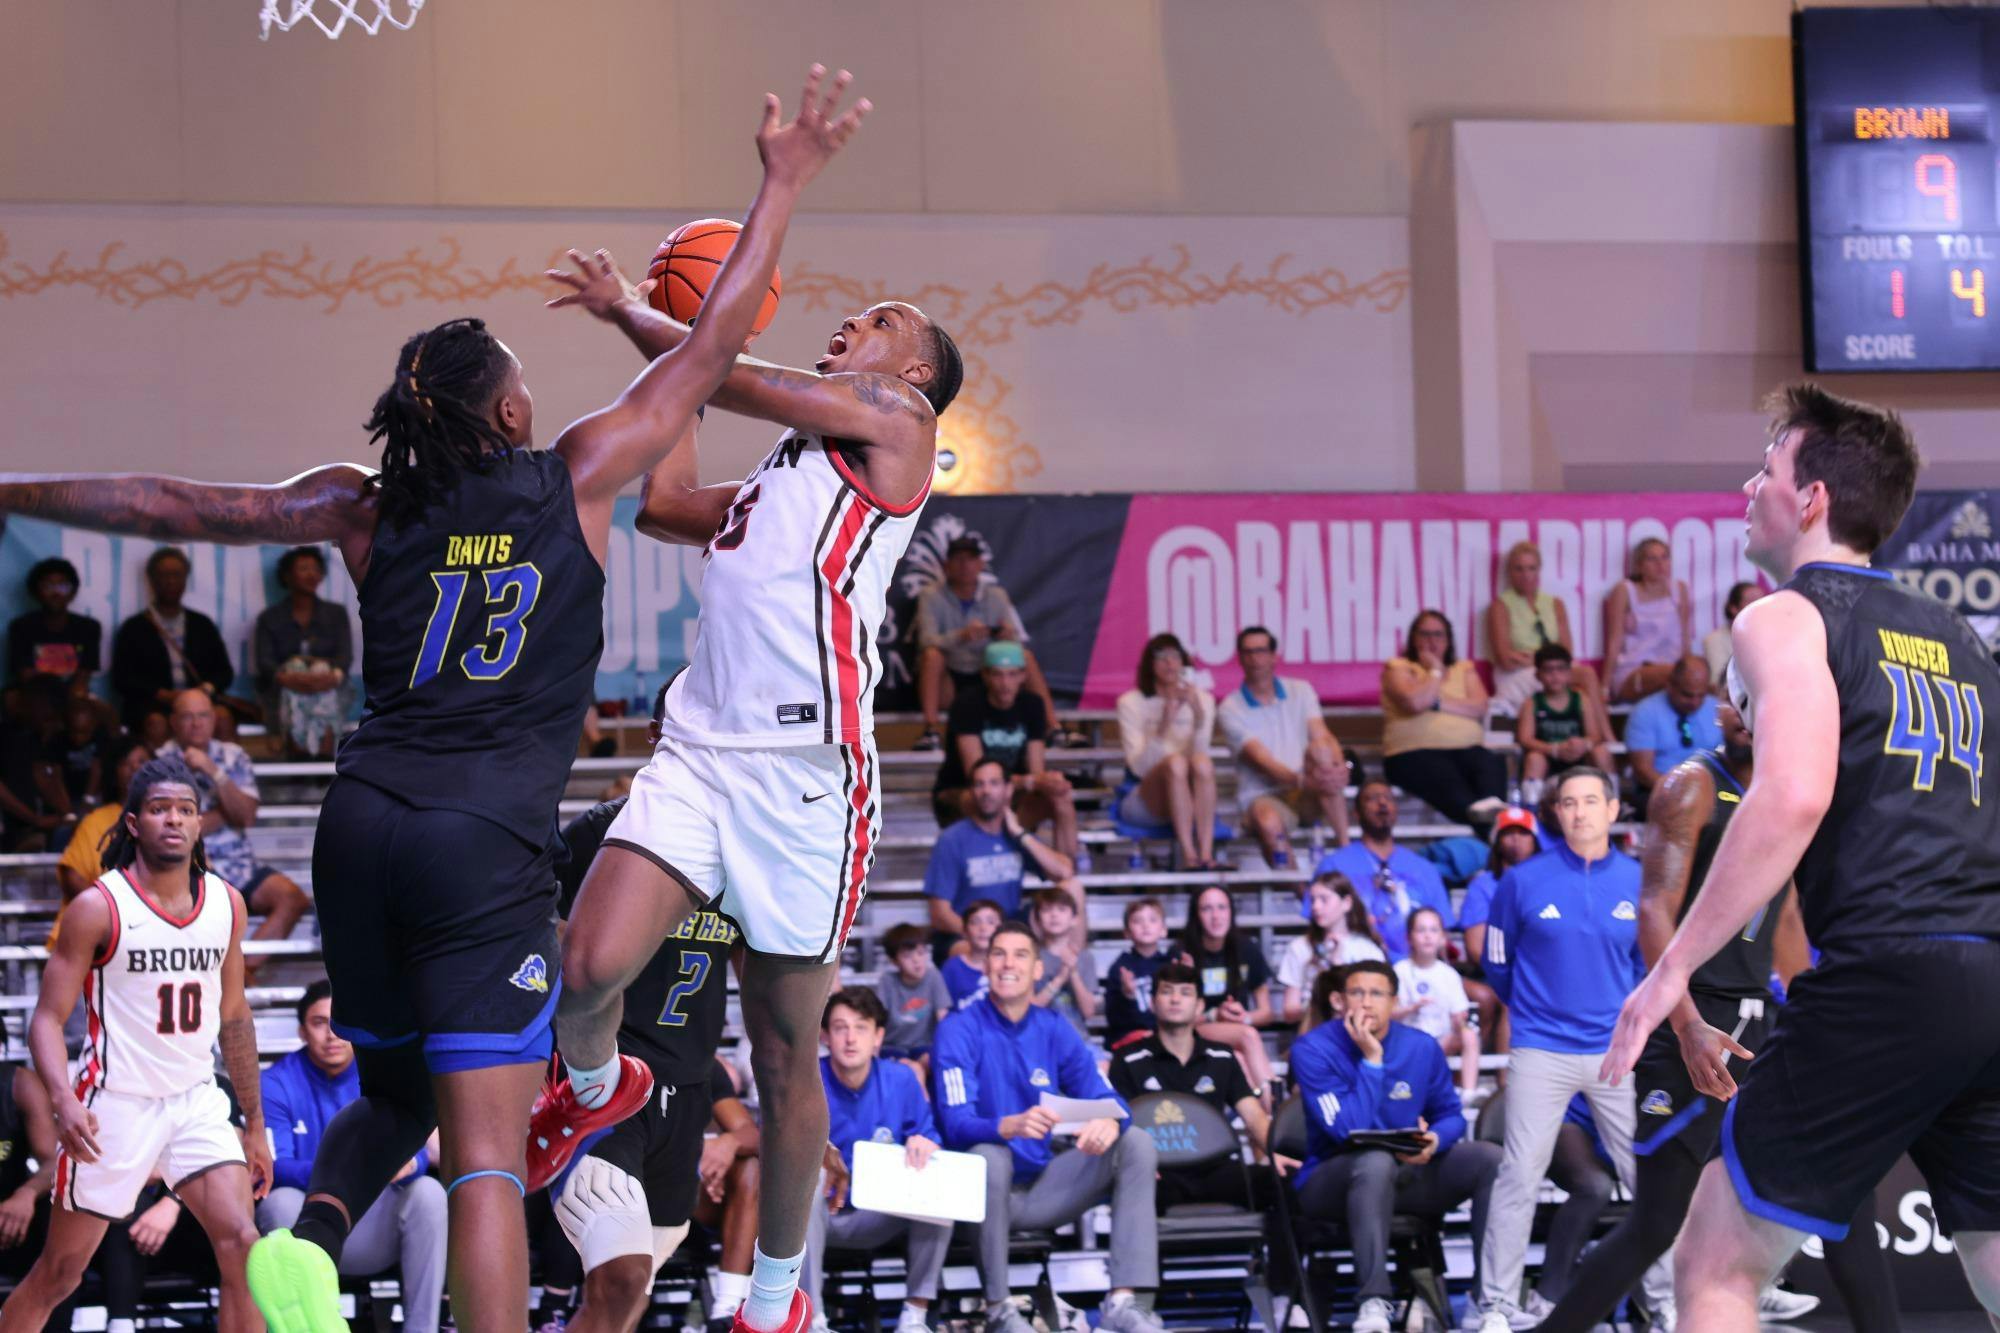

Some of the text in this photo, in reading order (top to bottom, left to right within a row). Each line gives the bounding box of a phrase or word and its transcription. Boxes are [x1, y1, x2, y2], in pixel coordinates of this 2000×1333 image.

[1854, 107, 1951, 139] BROWN
[1915, 154, 1958, 221] 9
[1843, 235, 1912, 261] FOULS
[1891, 269, 1905, 318] 1
[1951, 269, 1986, 318] 4
[1845, 334, 1917, 361] SCORE
[446, 534, 513, 566] DAVIS
[1907, 542, 1975, 562] BAHA
[409, 561, 543, 689] 13
[1878, 628, 1950, 677] HOUSER
[1879, 660, 1984, 807] 44
[126, 947, 226, 973] BROWN
[156, 981, 203, 1035] 10
[656, 949, 713, 1027] 2
